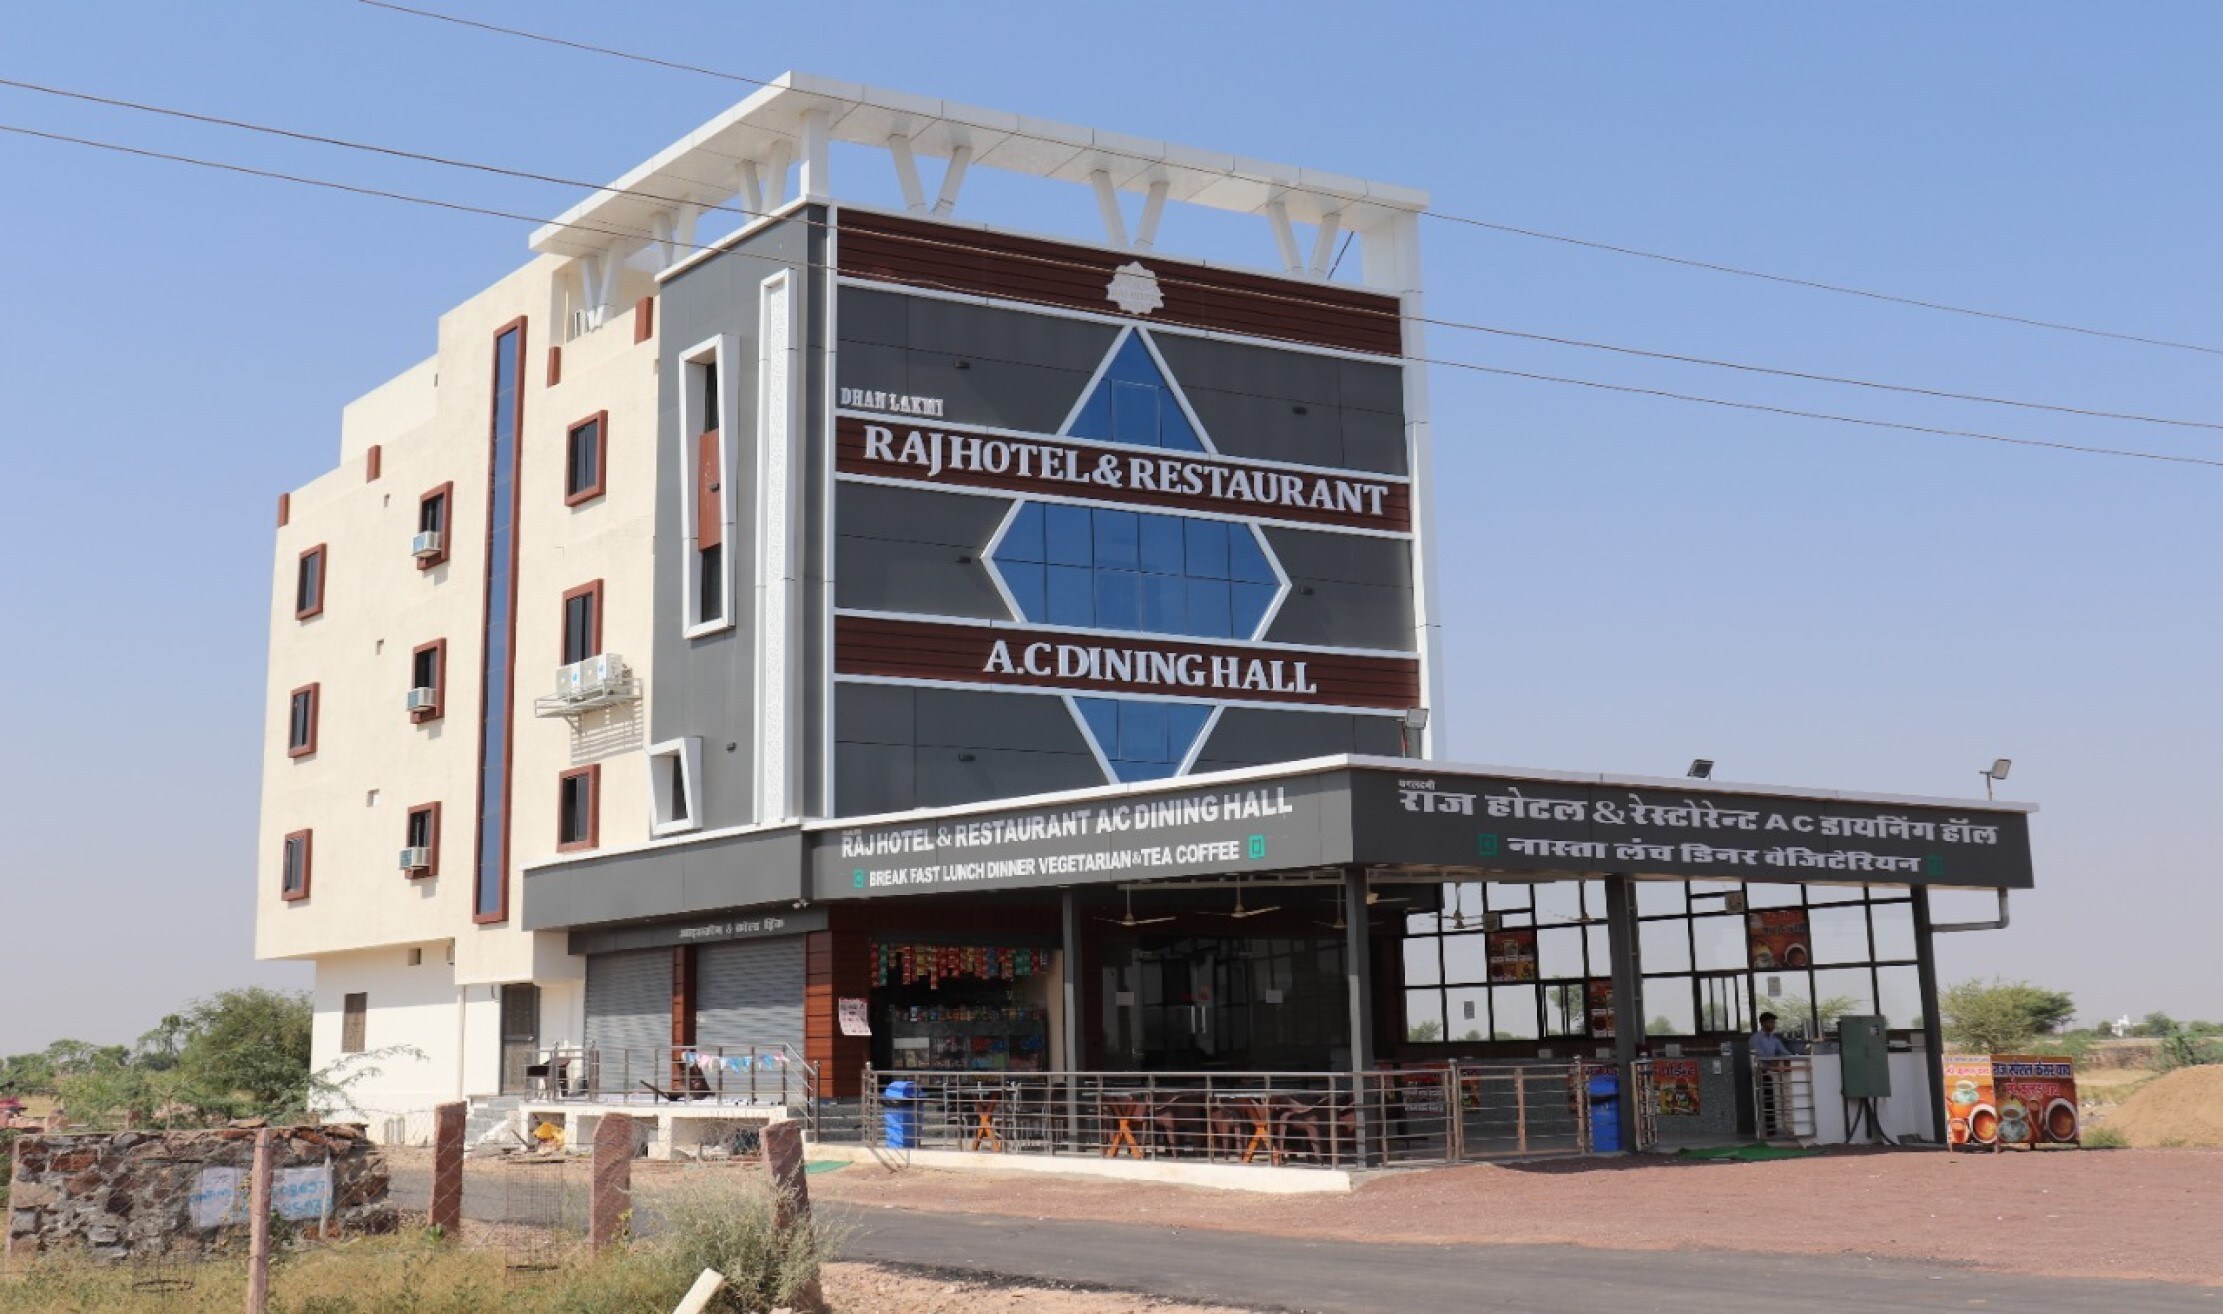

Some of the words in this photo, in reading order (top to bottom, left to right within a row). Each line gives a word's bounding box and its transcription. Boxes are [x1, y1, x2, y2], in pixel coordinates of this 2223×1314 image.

[840, 387, 887, 409] DHAN
[863, 424, 945, 477] RAJ
[948, 435, 1090, 483] HOTEL
[1091, 453, 1123, 488] &
[1127, 457, 1389, 516] RESTAURANT
[982, 639, 1052, 676] A.C
[1055, 644, 1207, 686] DINING
[1210, 655, 1317, 694] HALL
[841, 833, 875, 858] RAJ
[876, 828, 935, 855] HOTEL
[936, 825, 952, 848] &
[954, 808, 1091, 848] RESTAURANT
[1134, 794, 1219, 831] DINING
[1223, 786, 1293, 821] HALL
[1397, 789, 1477, 816] राज
[1484, 786, 1589, 821] होटल
[1592, 800, 1627, 825] &
[1628, 792, 1760, 830] रेस्टोरेन्ट
[1818, 814, 1936, 841] डायनिंग
[1939, 817, 1999, 845] हॉल
[869, 868, 908, 888] BREAK
[909, 865, 941, 885] FAST
[942, 861, 984, 883] LUNCH
[986, 857, 1036, 879] DINNER
[1038, 849, 1132, 875] VEGETARIAN
[1141, 846, 1173, 867] TEA
[1175, 839, 1241, 864] COFFEE
[1506, 837, 1609, 860] नास्ता
[1613, 837, 1675, 862] लंच
[1679, 843, 1760, 865] डिनर
[1763, 846, 1922, 873] वेजिटेरियन
